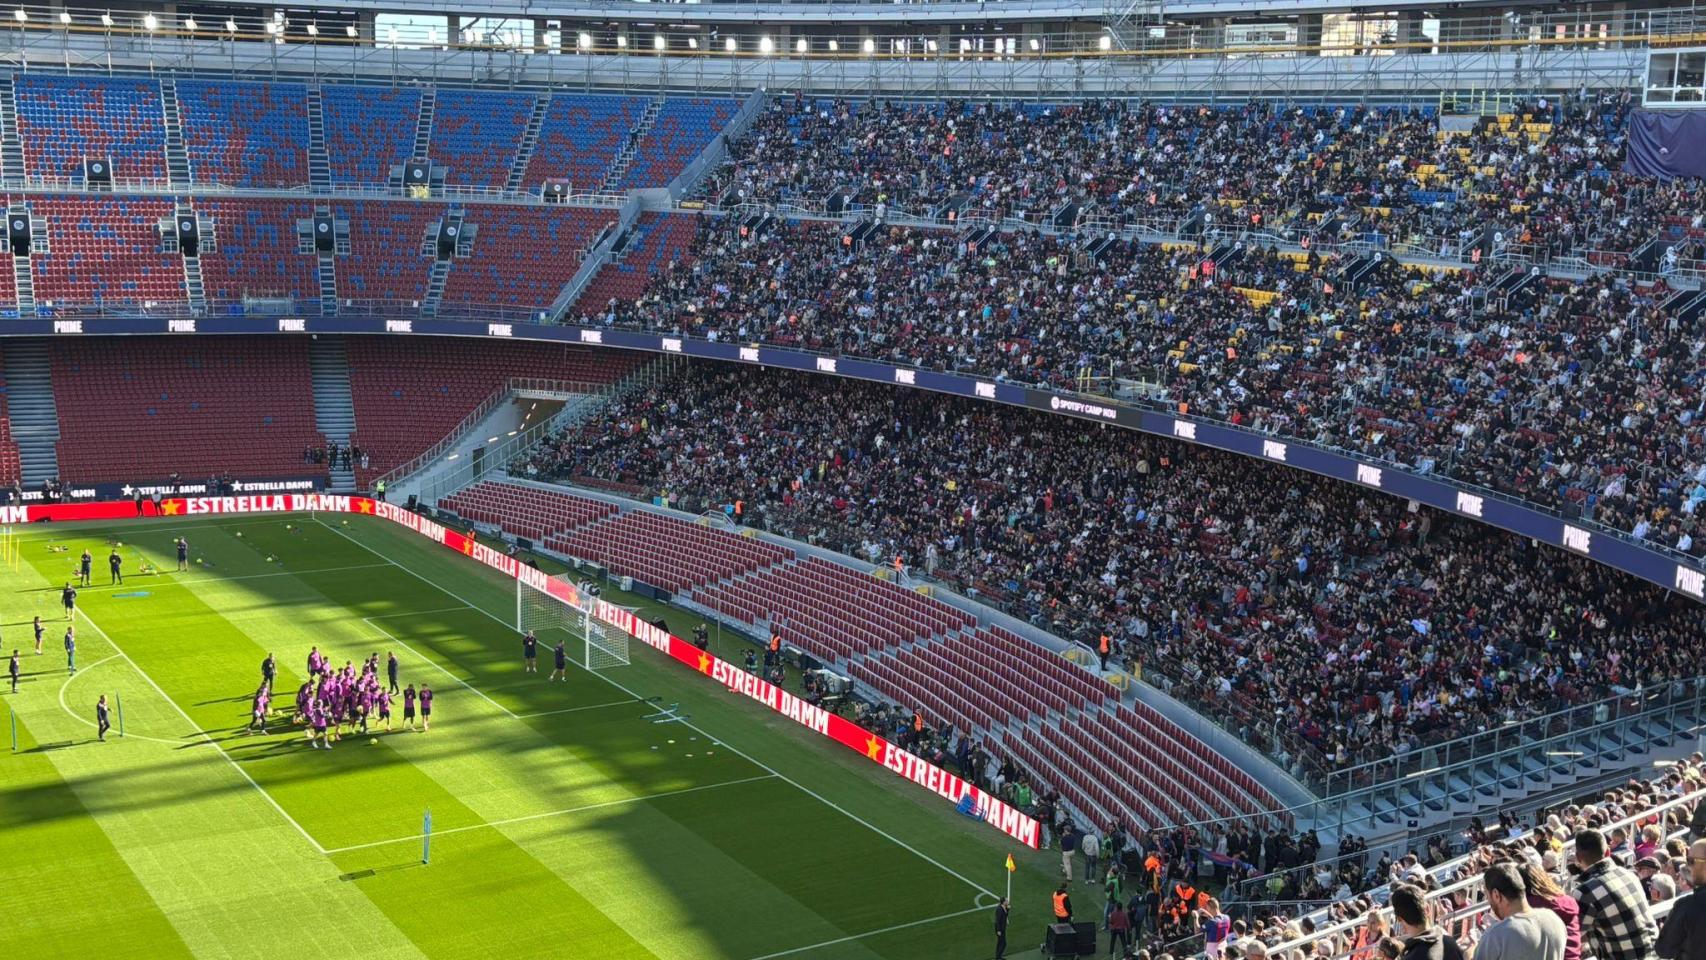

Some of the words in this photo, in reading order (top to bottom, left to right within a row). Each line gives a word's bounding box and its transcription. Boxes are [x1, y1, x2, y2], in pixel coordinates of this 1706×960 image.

[54, 320, 83, 334] PRIME
[168, 319, 196, 332] PRIME
[278, 319, 306, 332] PRIME
[386, 319, 412, 333] PRIME
[488, 323, 513, 337] PRIME
[1060, 399, 1085, 413] SPOTIFY
[1085, 404, 1103, 416] CAMP
[1103, 408, 1117, 419] NOU
[1174, 419, 1197, 440] PRIME
[1263, 439, 1287, 461] PRIME
[1357, 463, 1382, 487] PRIME
[179, 484, 206, 494] DAMM
[245, 482, 285, 491] ESTRELLA
[286, 481, 313, 489] DAMM
[187, 496, 286, 514] ESTRELLA
[291, 494, 350, 512] DAMM
[1456, 491, 1484, 517] PRIME
[375, 500, 418, 533] ESTRELLA
[419, 515, 446, 544] DAMM
[1562, 524, 1591, 554] PRIME
[472, 541, 516, 577] ESTRELLA
[518, 561, 548, 591] DAMM
[1675, 564, 1706, 598] PRIME
[635, 616, 671, 654] DAMM
[712, 656, 777, 709] ESTRELLA
[781, 690, 830, 735] DAMM
[977, 789, 1040, 849] DAMM
